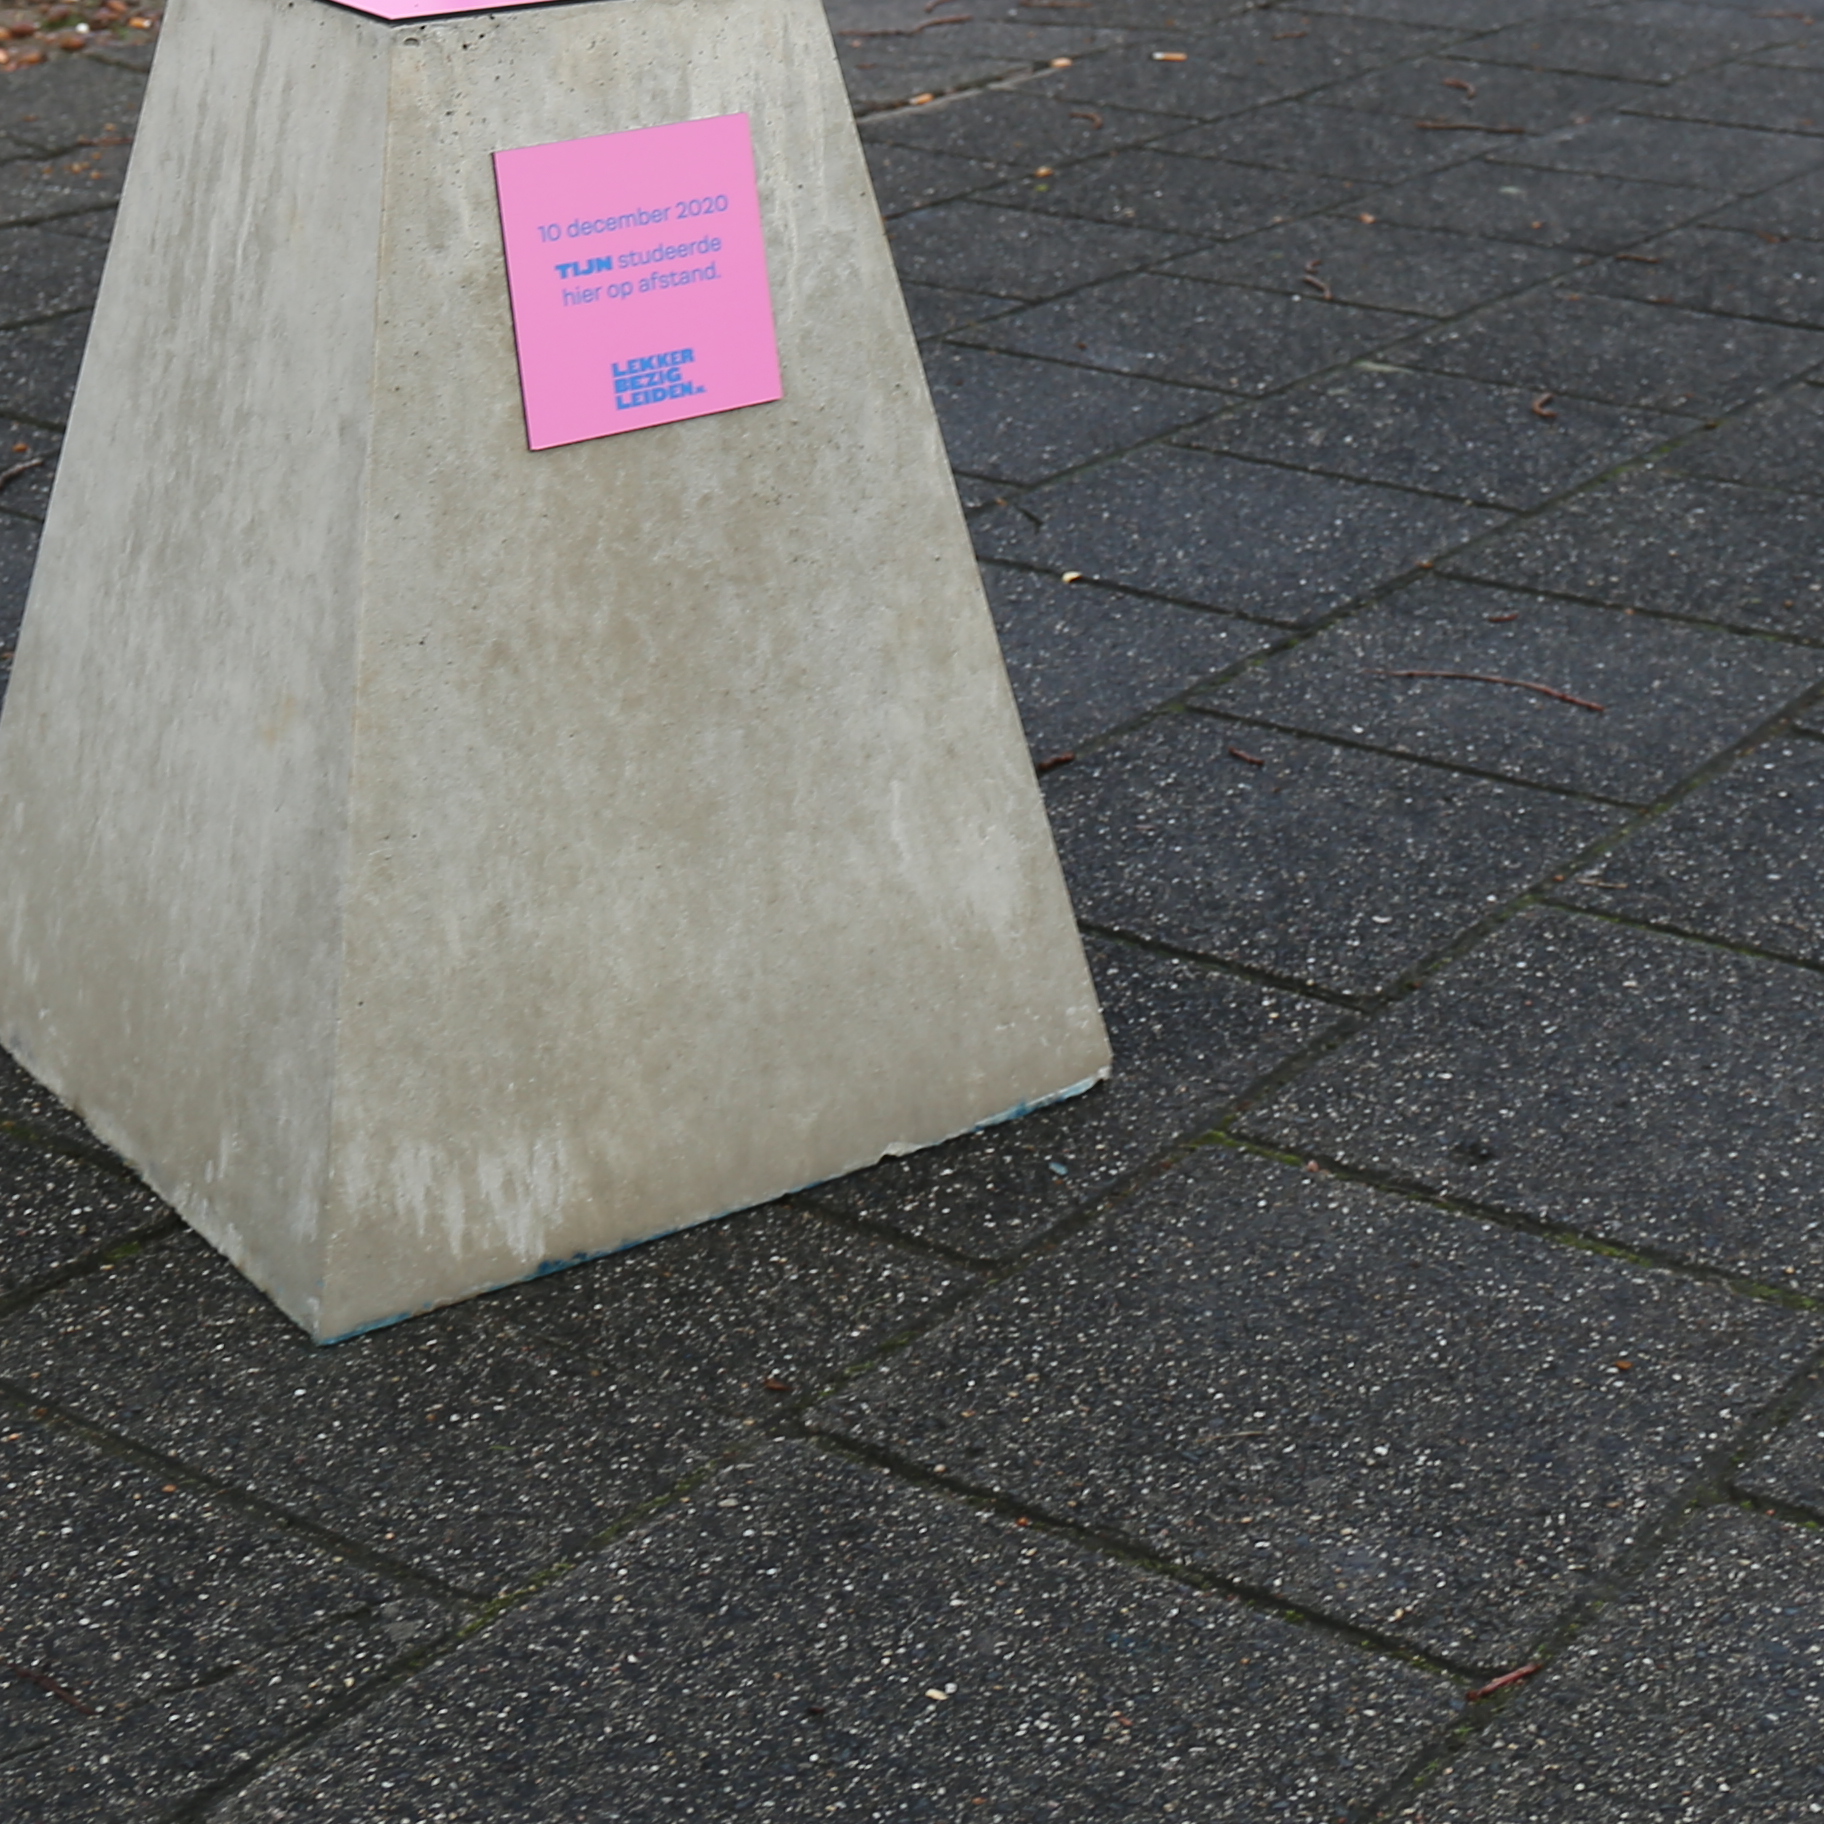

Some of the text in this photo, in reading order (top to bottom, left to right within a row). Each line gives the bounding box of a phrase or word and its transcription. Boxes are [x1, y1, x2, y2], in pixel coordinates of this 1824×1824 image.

[538, 194, 729, 243] 10 december 2020
[555, 235, 722, 279] TIJN studeerde
[562, 262, 721, 307] hier op afstand.
[611, 348, 695, 377] LEKKER
[614, 367, 682, 393] BEZIG
